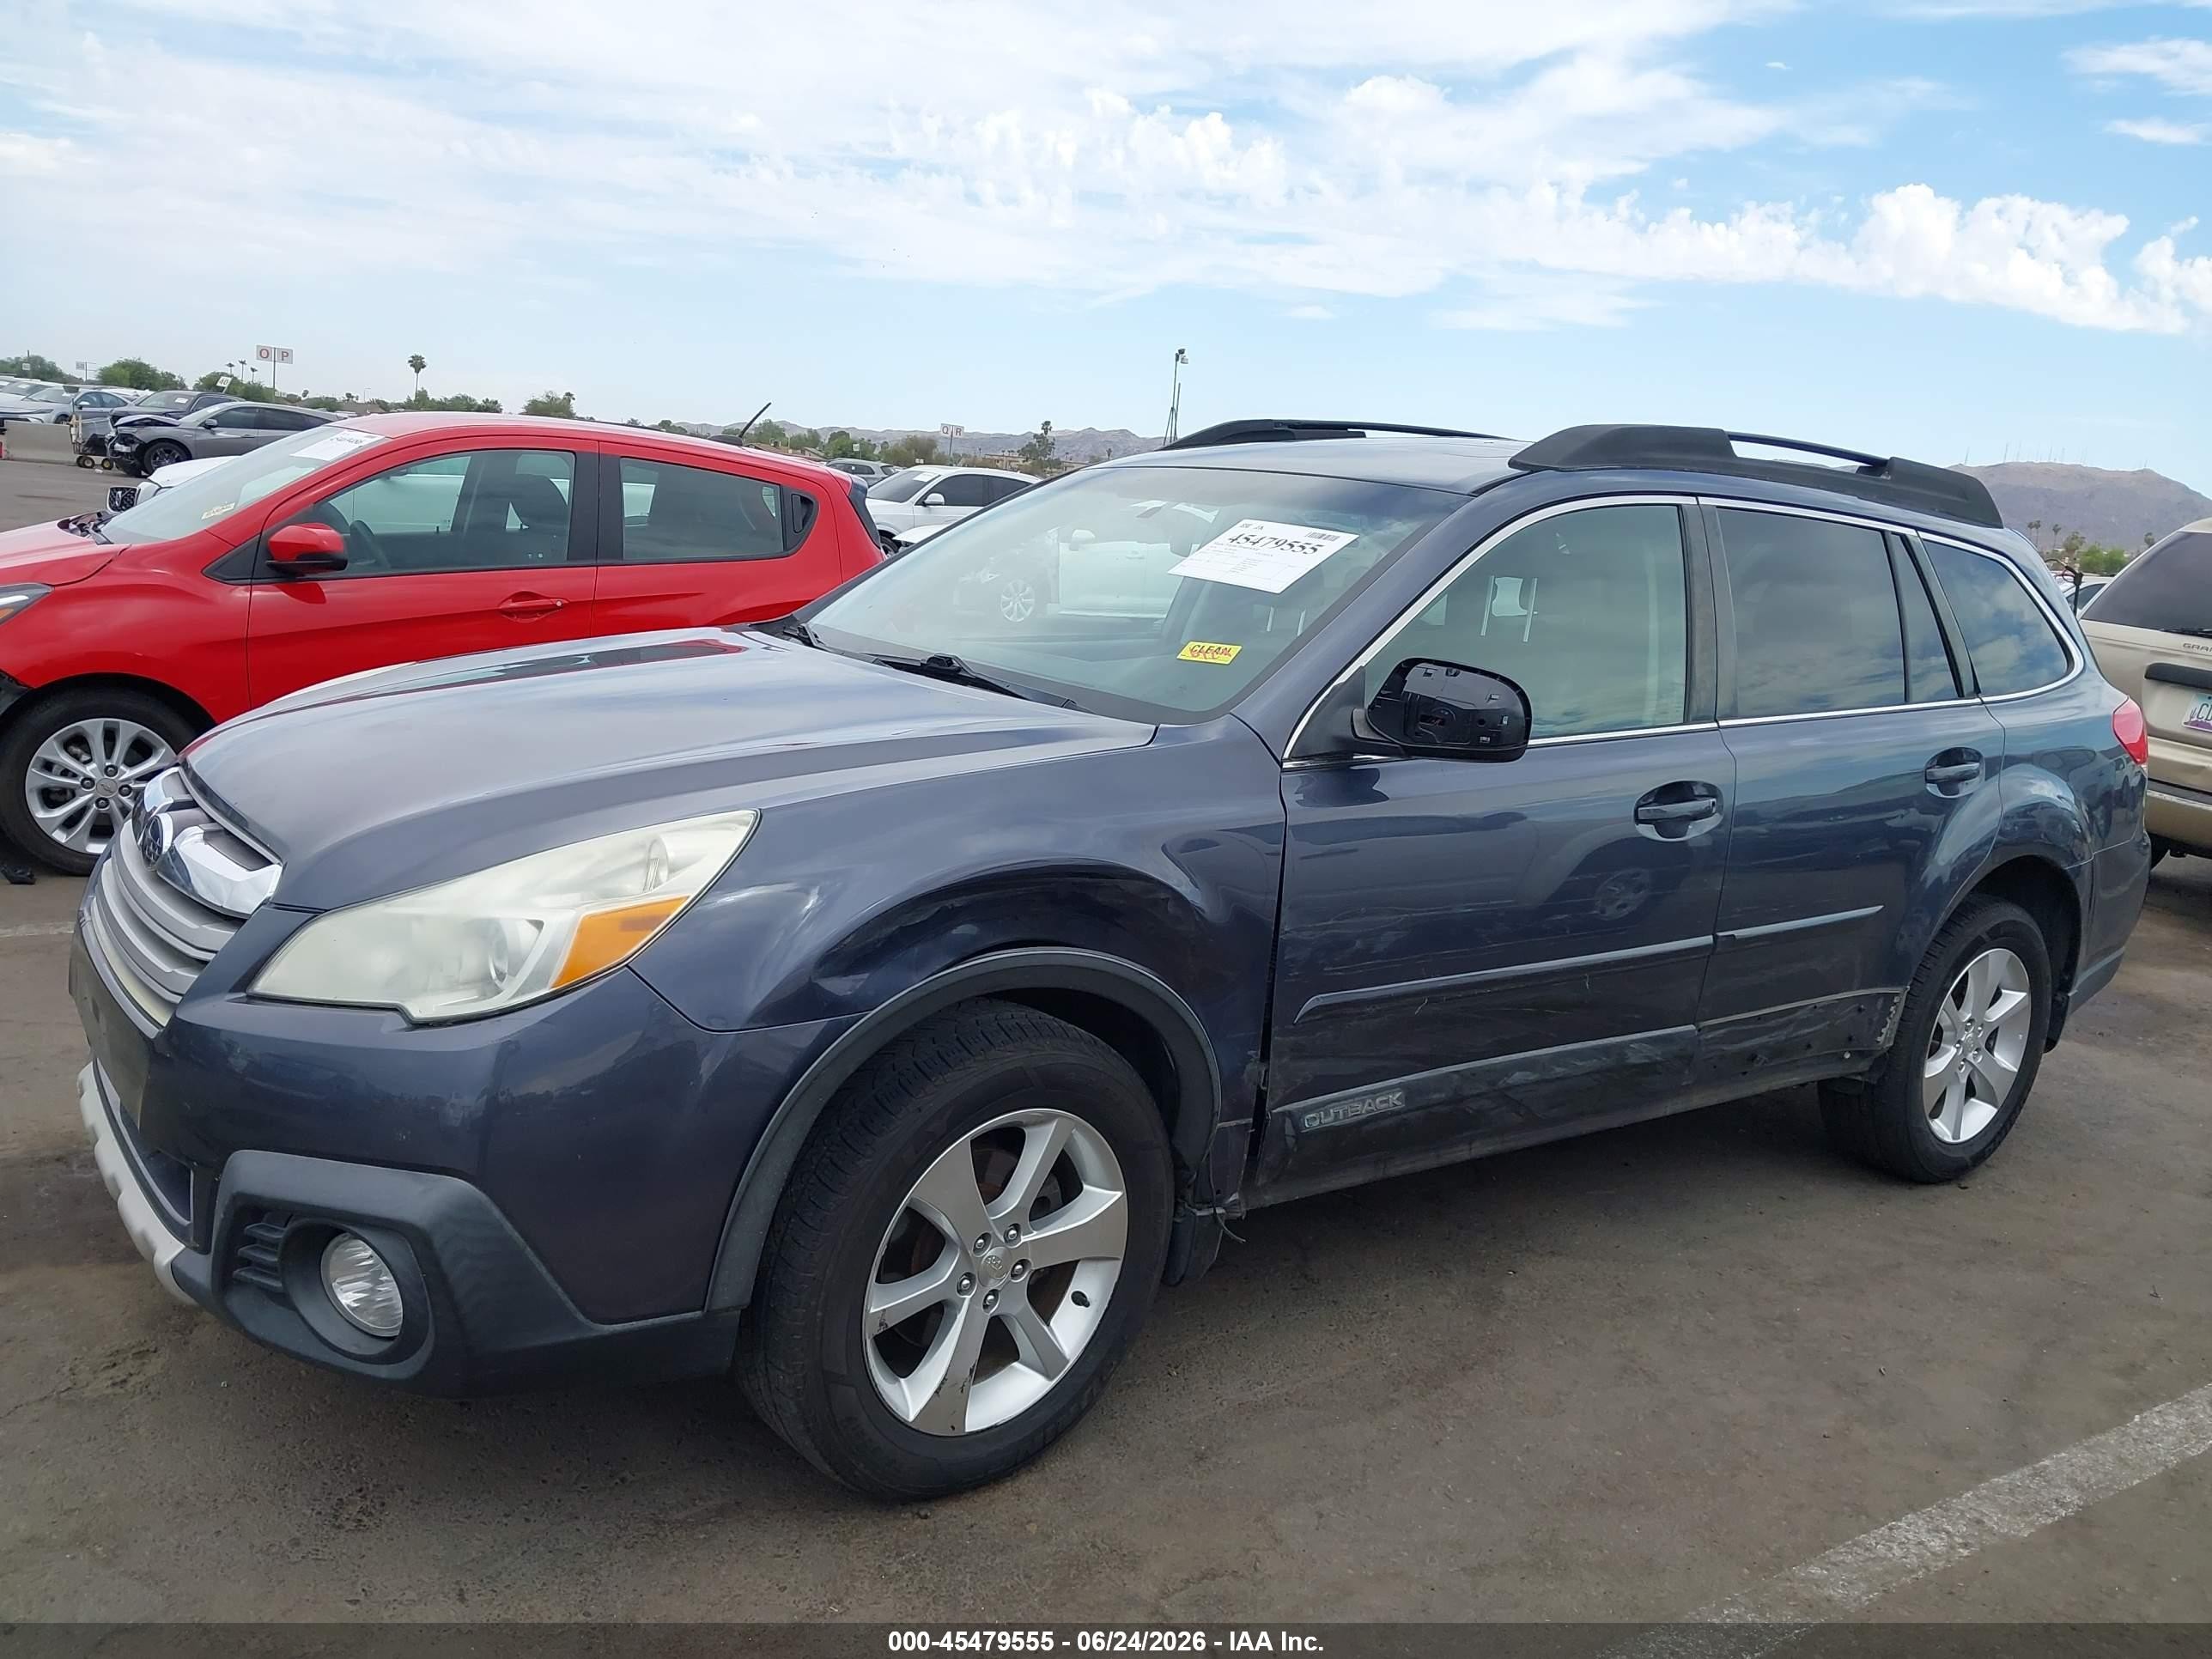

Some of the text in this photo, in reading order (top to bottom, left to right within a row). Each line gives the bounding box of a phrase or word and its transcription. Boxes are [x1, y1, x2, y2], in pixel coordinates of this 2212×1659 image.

[259, 349, 289, 361] O P
[942, 425, 963, 436] Q R
[1228, 533, 1325, 555] 45479555
[1191, 644, 1231, 656] CLEAN
[2183, 642, 2212, 653] GRA
[1304, 1091, 1403, 1128] OUTBACK
